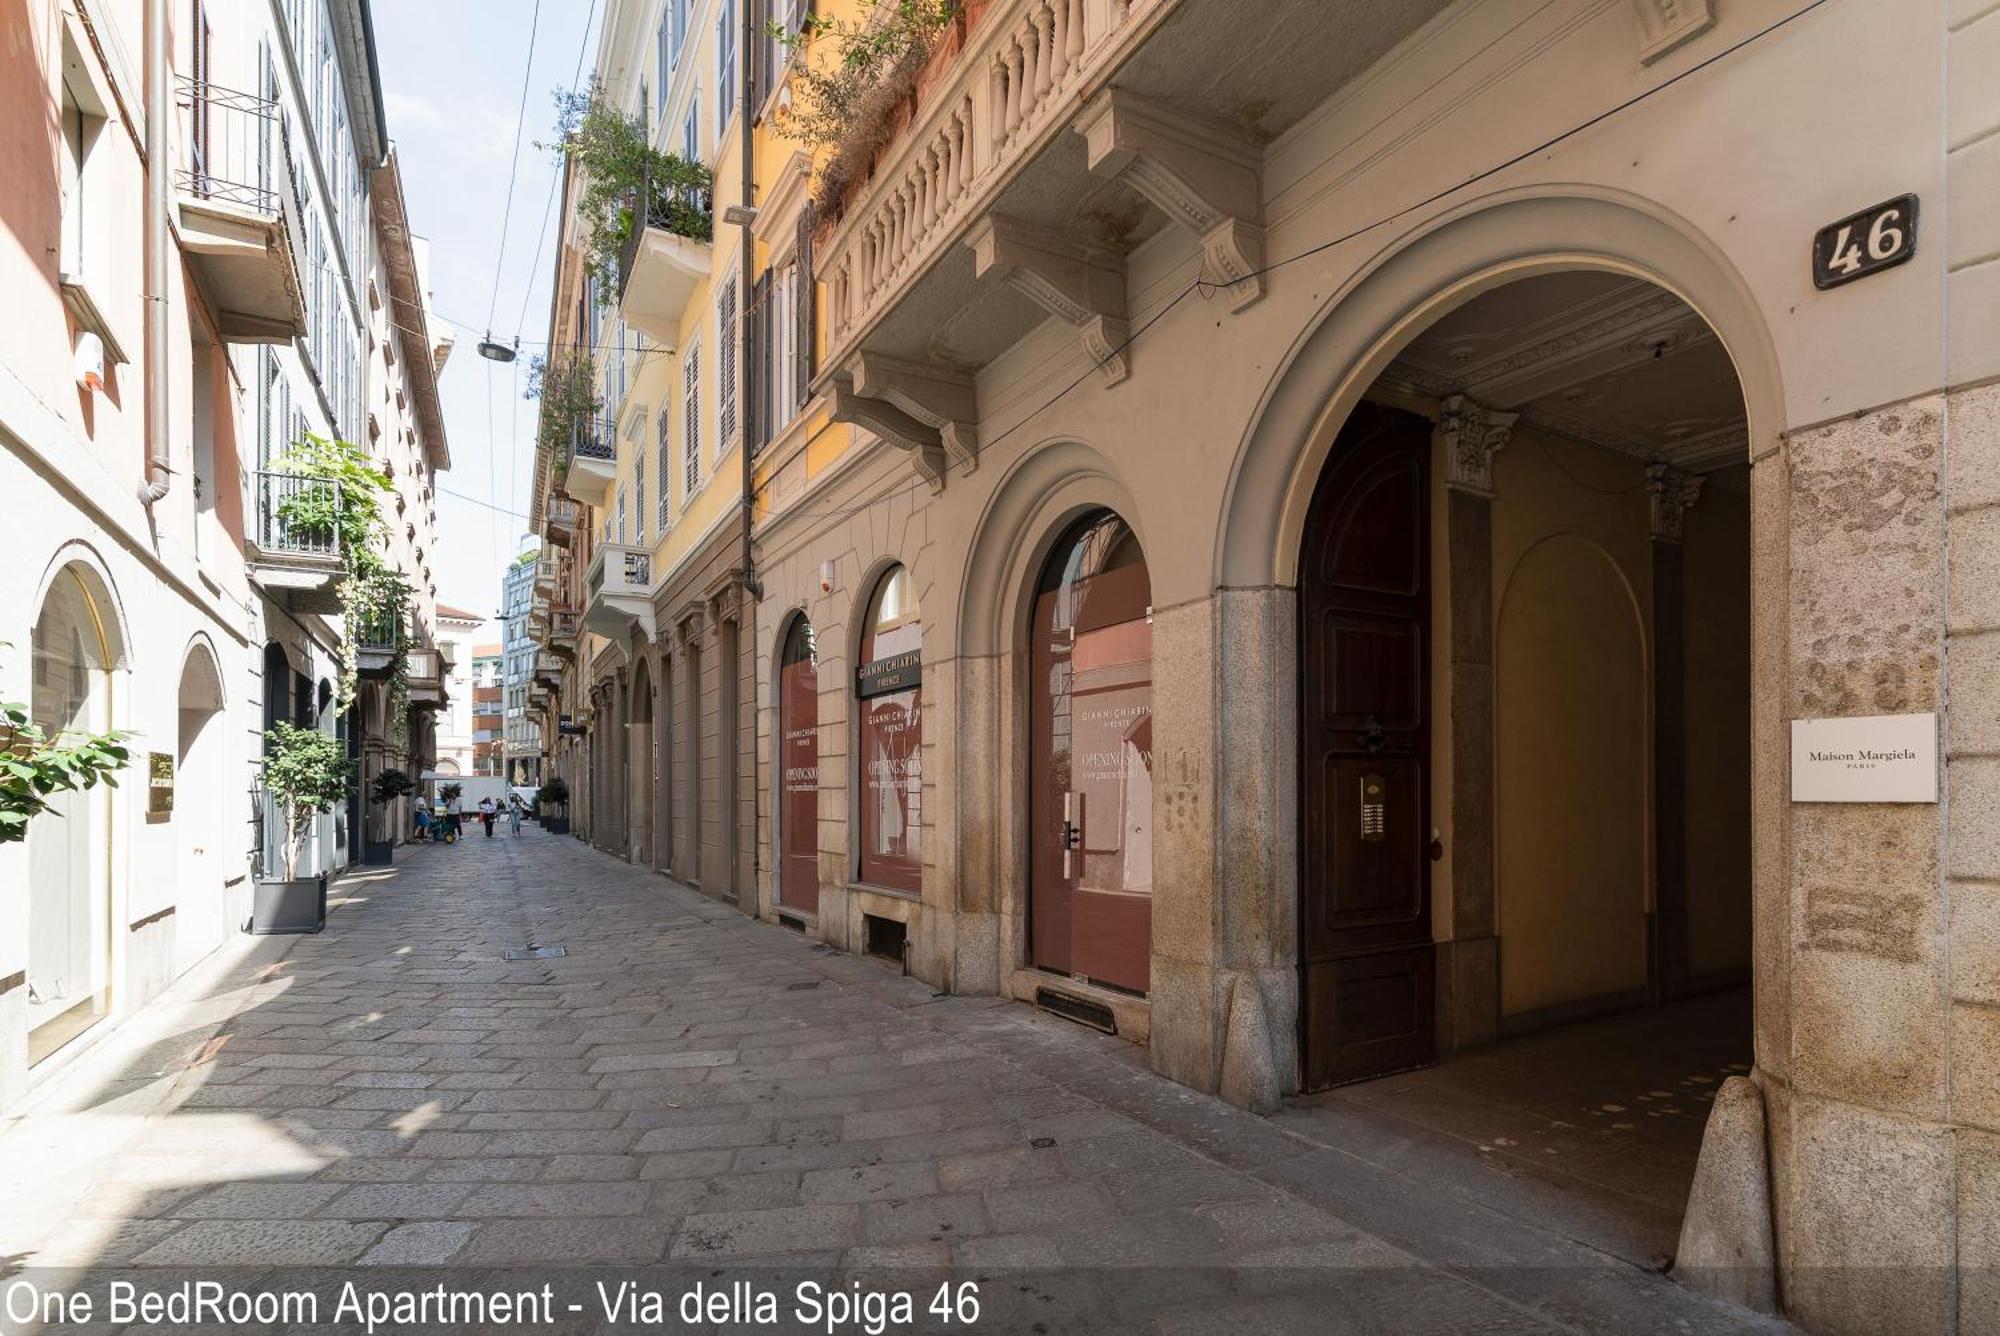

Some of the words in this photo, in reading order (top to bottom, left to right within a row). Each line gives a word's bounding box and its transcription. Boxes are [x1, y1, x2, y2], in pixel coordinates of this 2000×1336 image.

[1828, 209, 1902, 274] 46
[1809, 751, 1854, 761] Maison
[1858, 748, 1916, 762] Margiela
